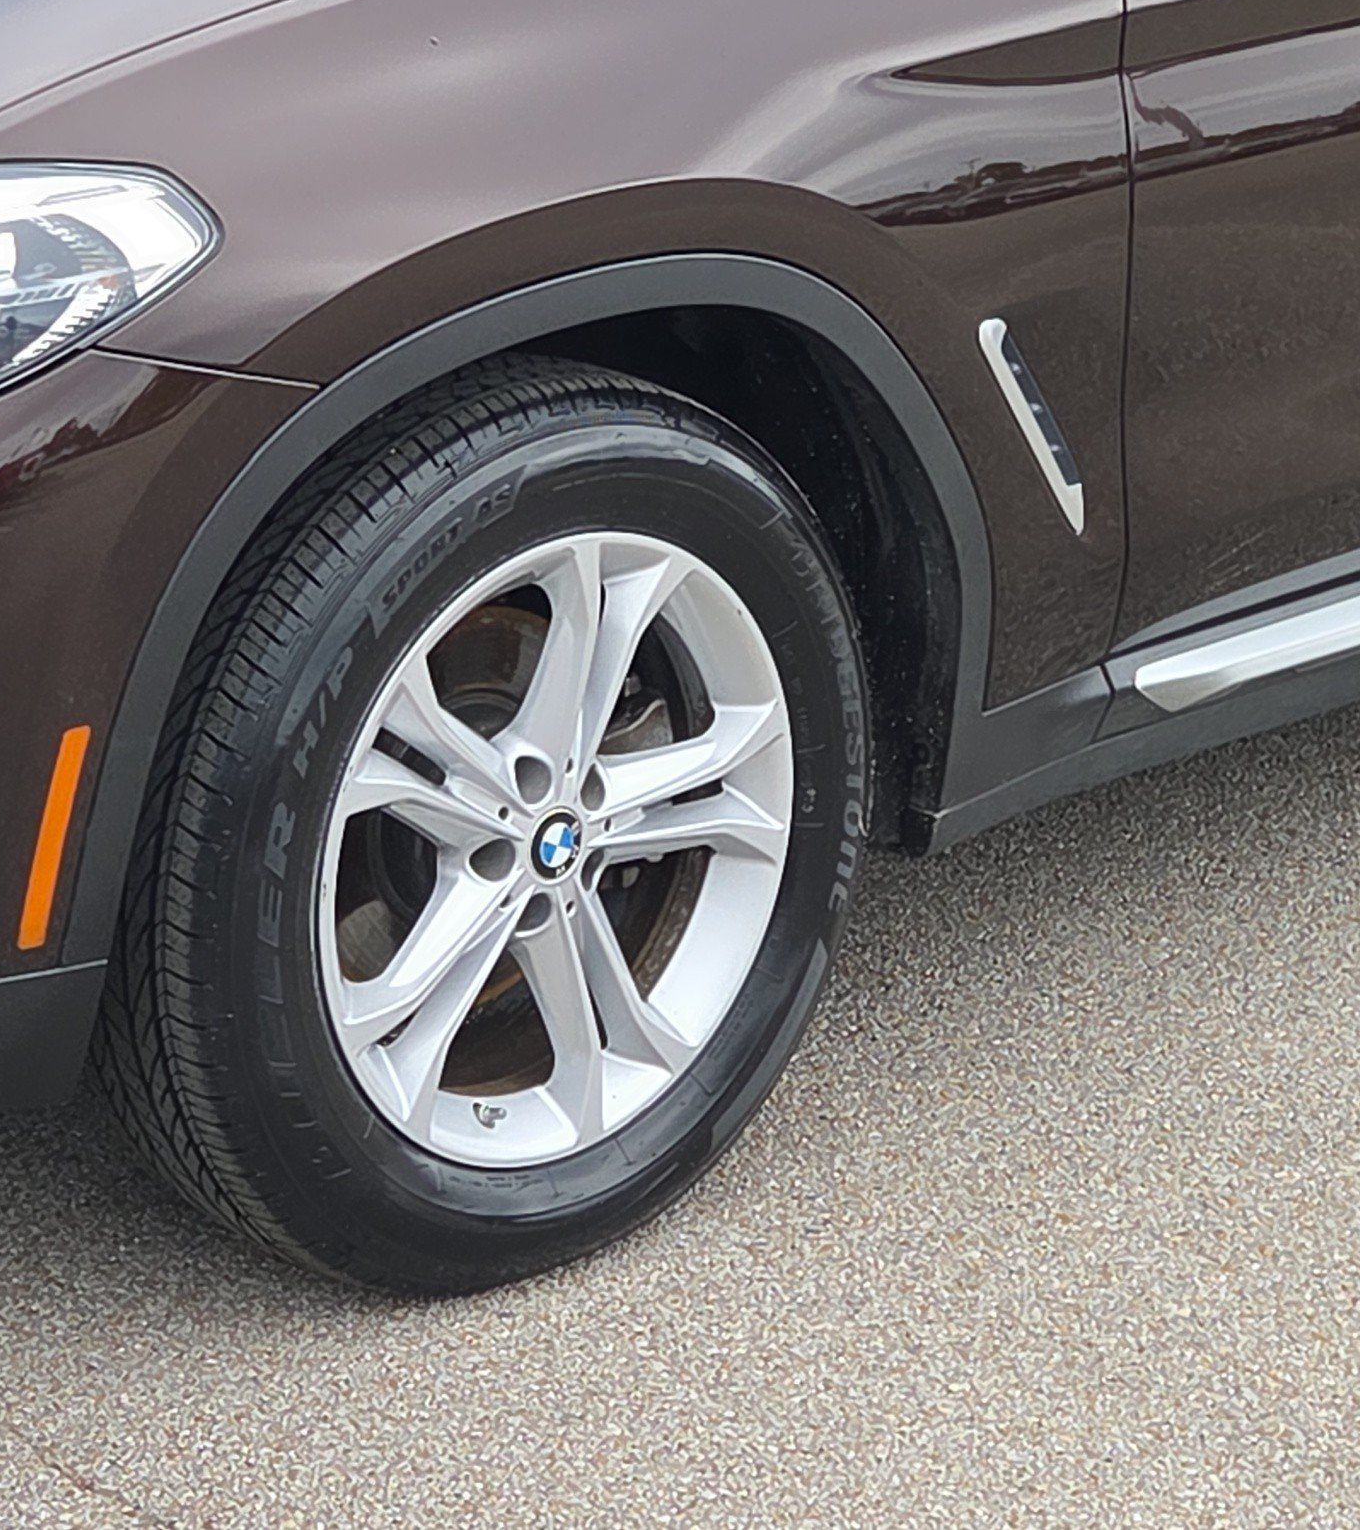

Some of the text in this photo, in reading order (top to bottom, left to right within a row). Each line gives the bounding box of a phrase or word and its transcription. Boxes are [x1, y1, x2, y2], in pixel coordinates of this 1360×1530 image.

[293, 646, 354, 779] H/P
[380, 516, 463, 612] SPORT
[475, 481, 513, 516] AS
